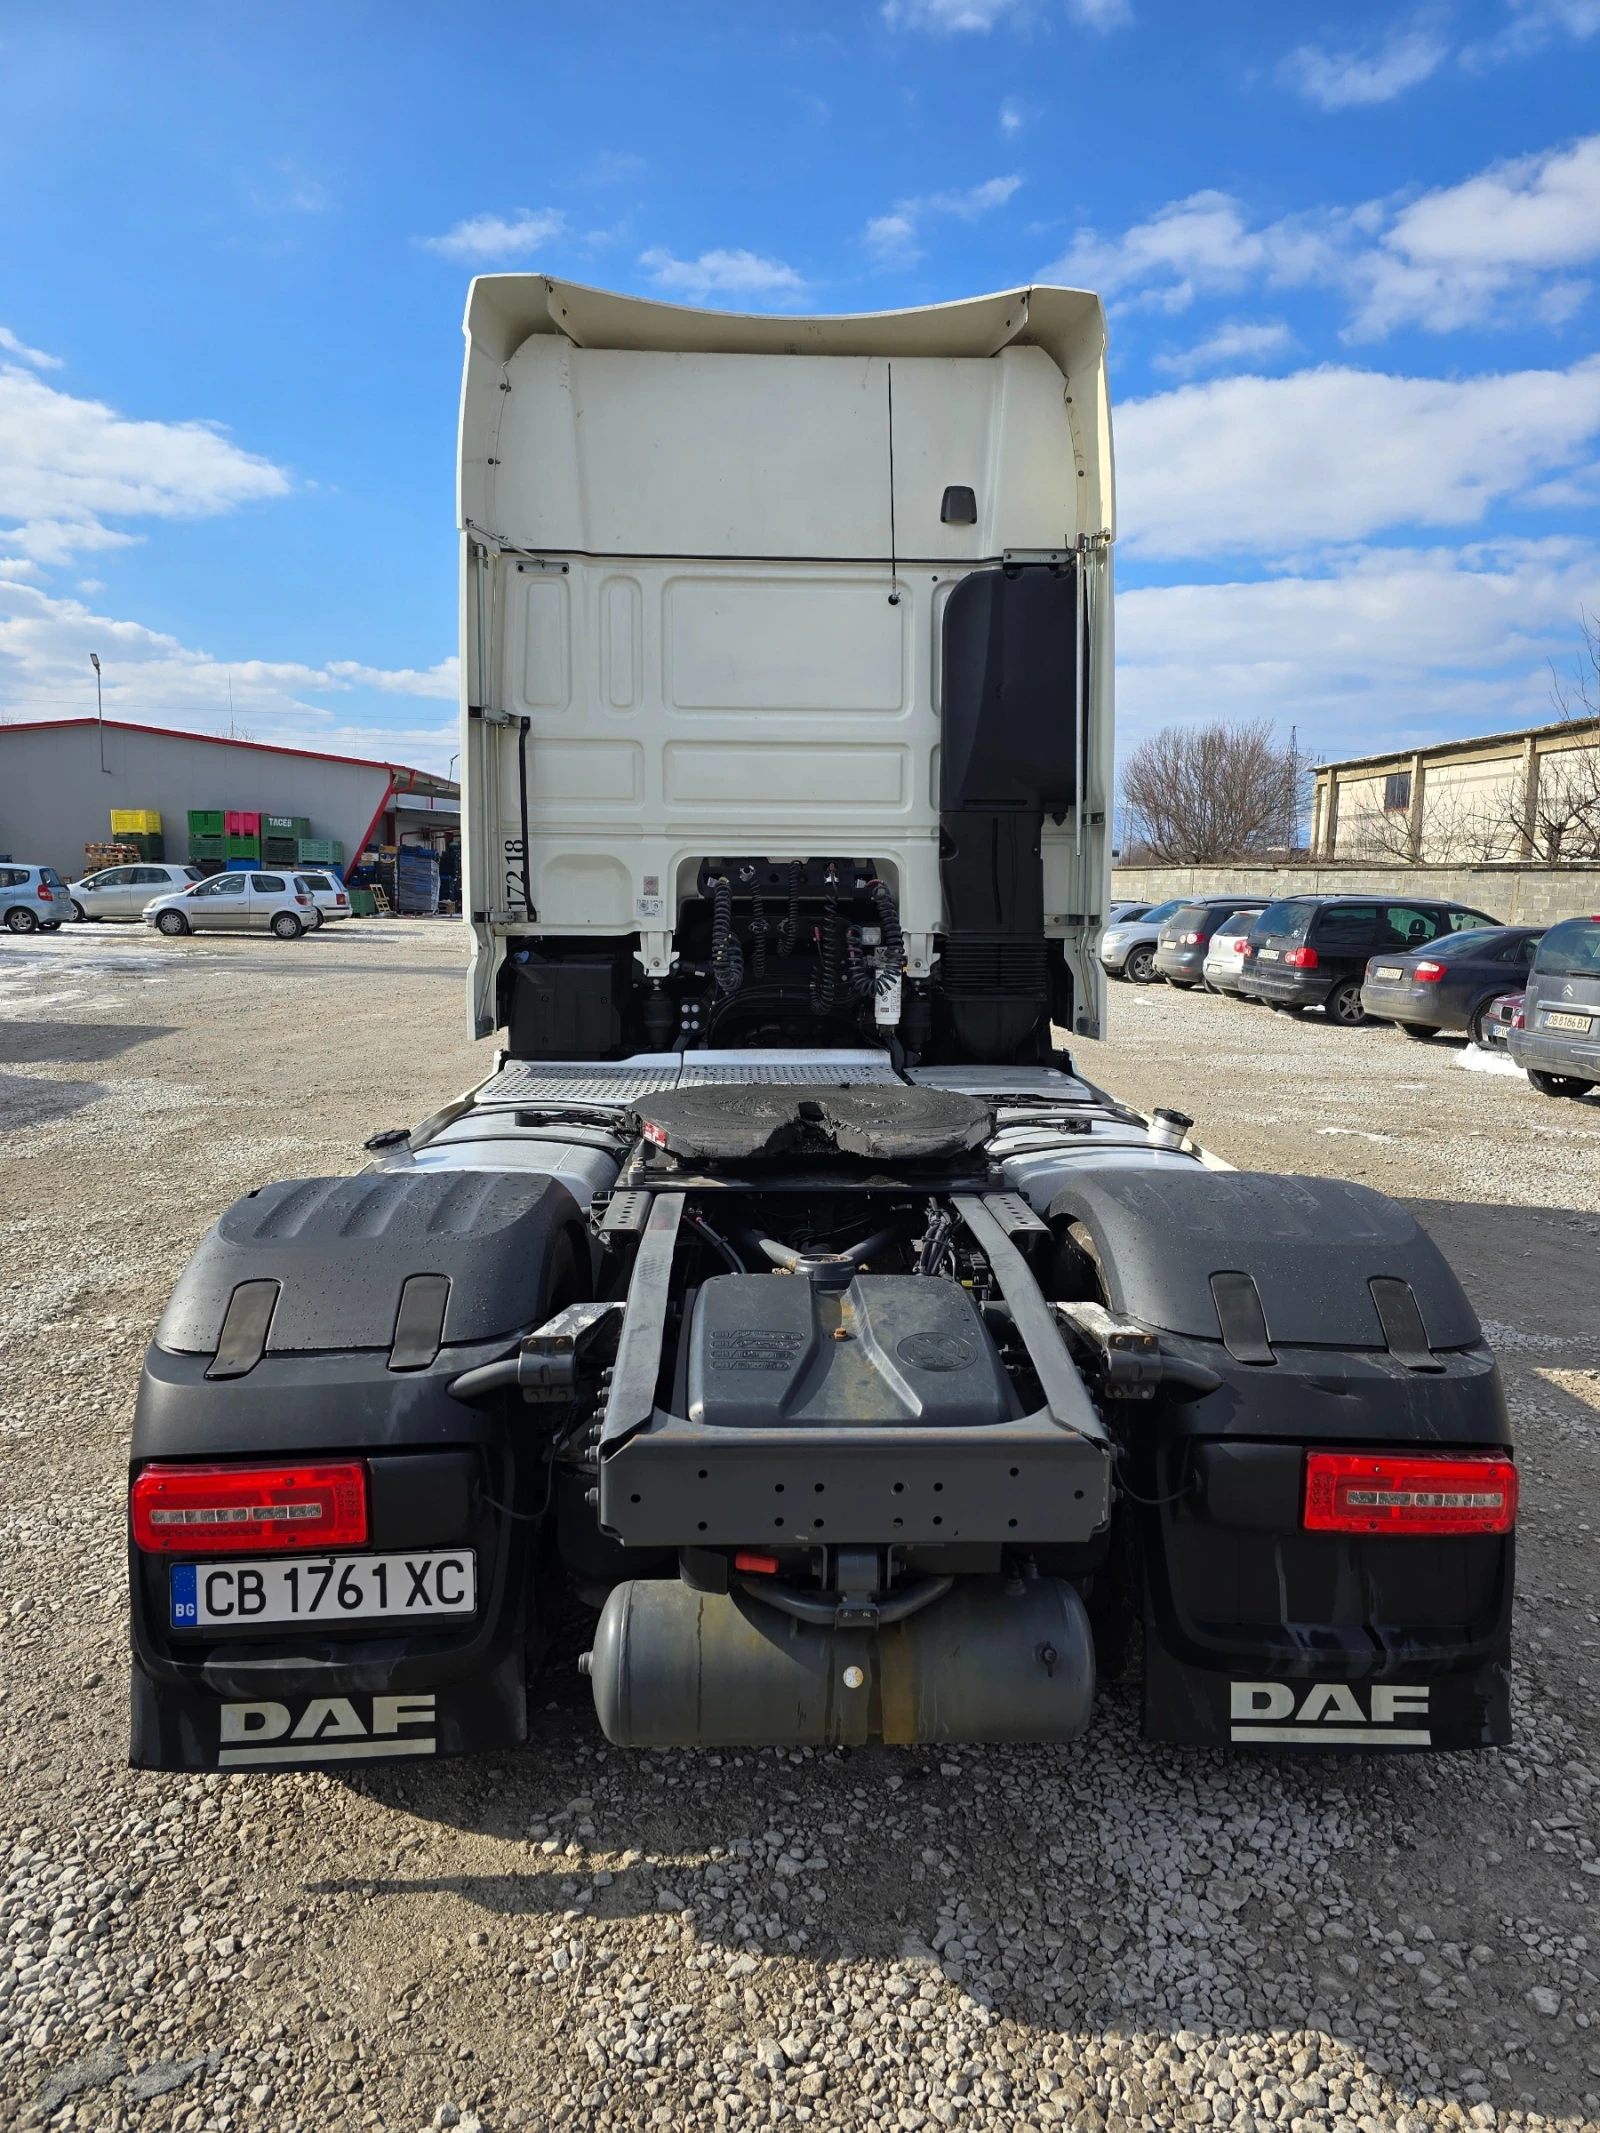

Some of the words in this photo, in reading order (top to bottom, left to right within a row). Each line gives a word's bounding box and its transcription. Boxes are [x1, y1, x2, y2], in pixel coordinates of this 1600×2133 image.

[1577, 1018, 1589, 1029] BX
[205, 1570, 267, 1617] CB
[284, 1562, 388, 1613] 1761
[405, 1559, 465, 1607] XC
[175, 1604, 195, 1618] BG
[219, 1694, 436, 1743] DAF
[1230, 1681, 1430, 1722] DAF
